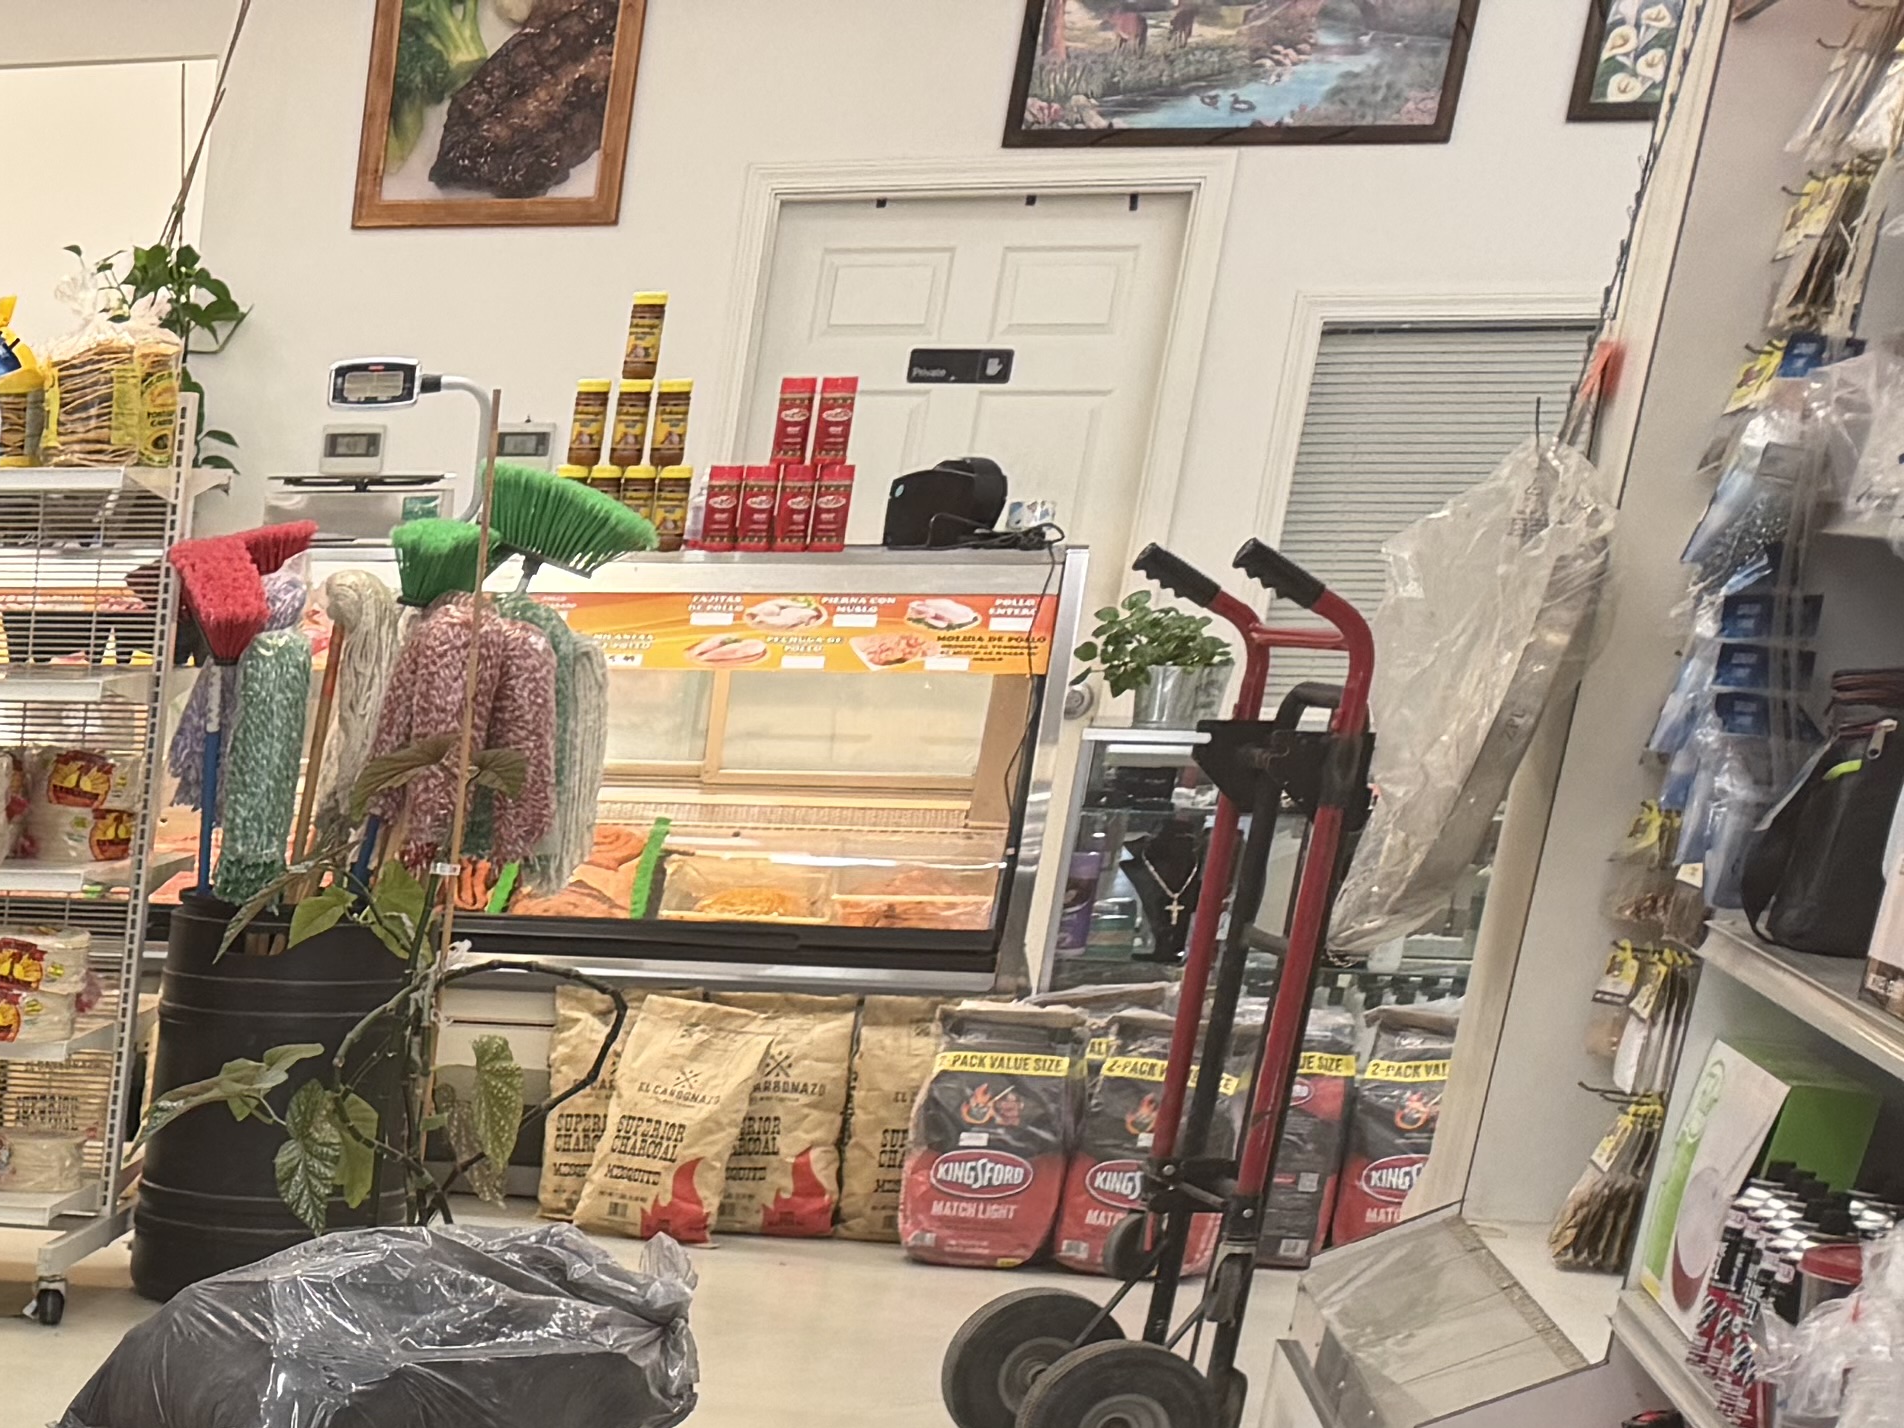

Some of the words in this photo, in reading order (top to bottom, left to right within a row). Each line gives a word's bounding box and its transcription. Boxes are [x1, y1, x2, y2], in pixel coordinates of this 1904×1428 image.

[995, 598, 1036, 607] POLLO
[1008, 635, 1047, 643] POLLO
[938, 1051, 987, 1070] 2-PACK
[989, 1054, 1031, 1072] VALUE
[1033, 1057, 1064, 1073] SIZE
[1106, 1058, 1159, 1079] 2-PACK
[1365, 1059, 1414, 1080] 2-PACK
[616, 1114, 687, 1143] SUPERIOR
[610, 1134, 679, 1163] CHARCOAL
[937, 1157, 1025, 1189] KINGSFORD
[931, 1200, 976, 1219] MATCH
[977, 1202, 1019, 1220] LIGHT
